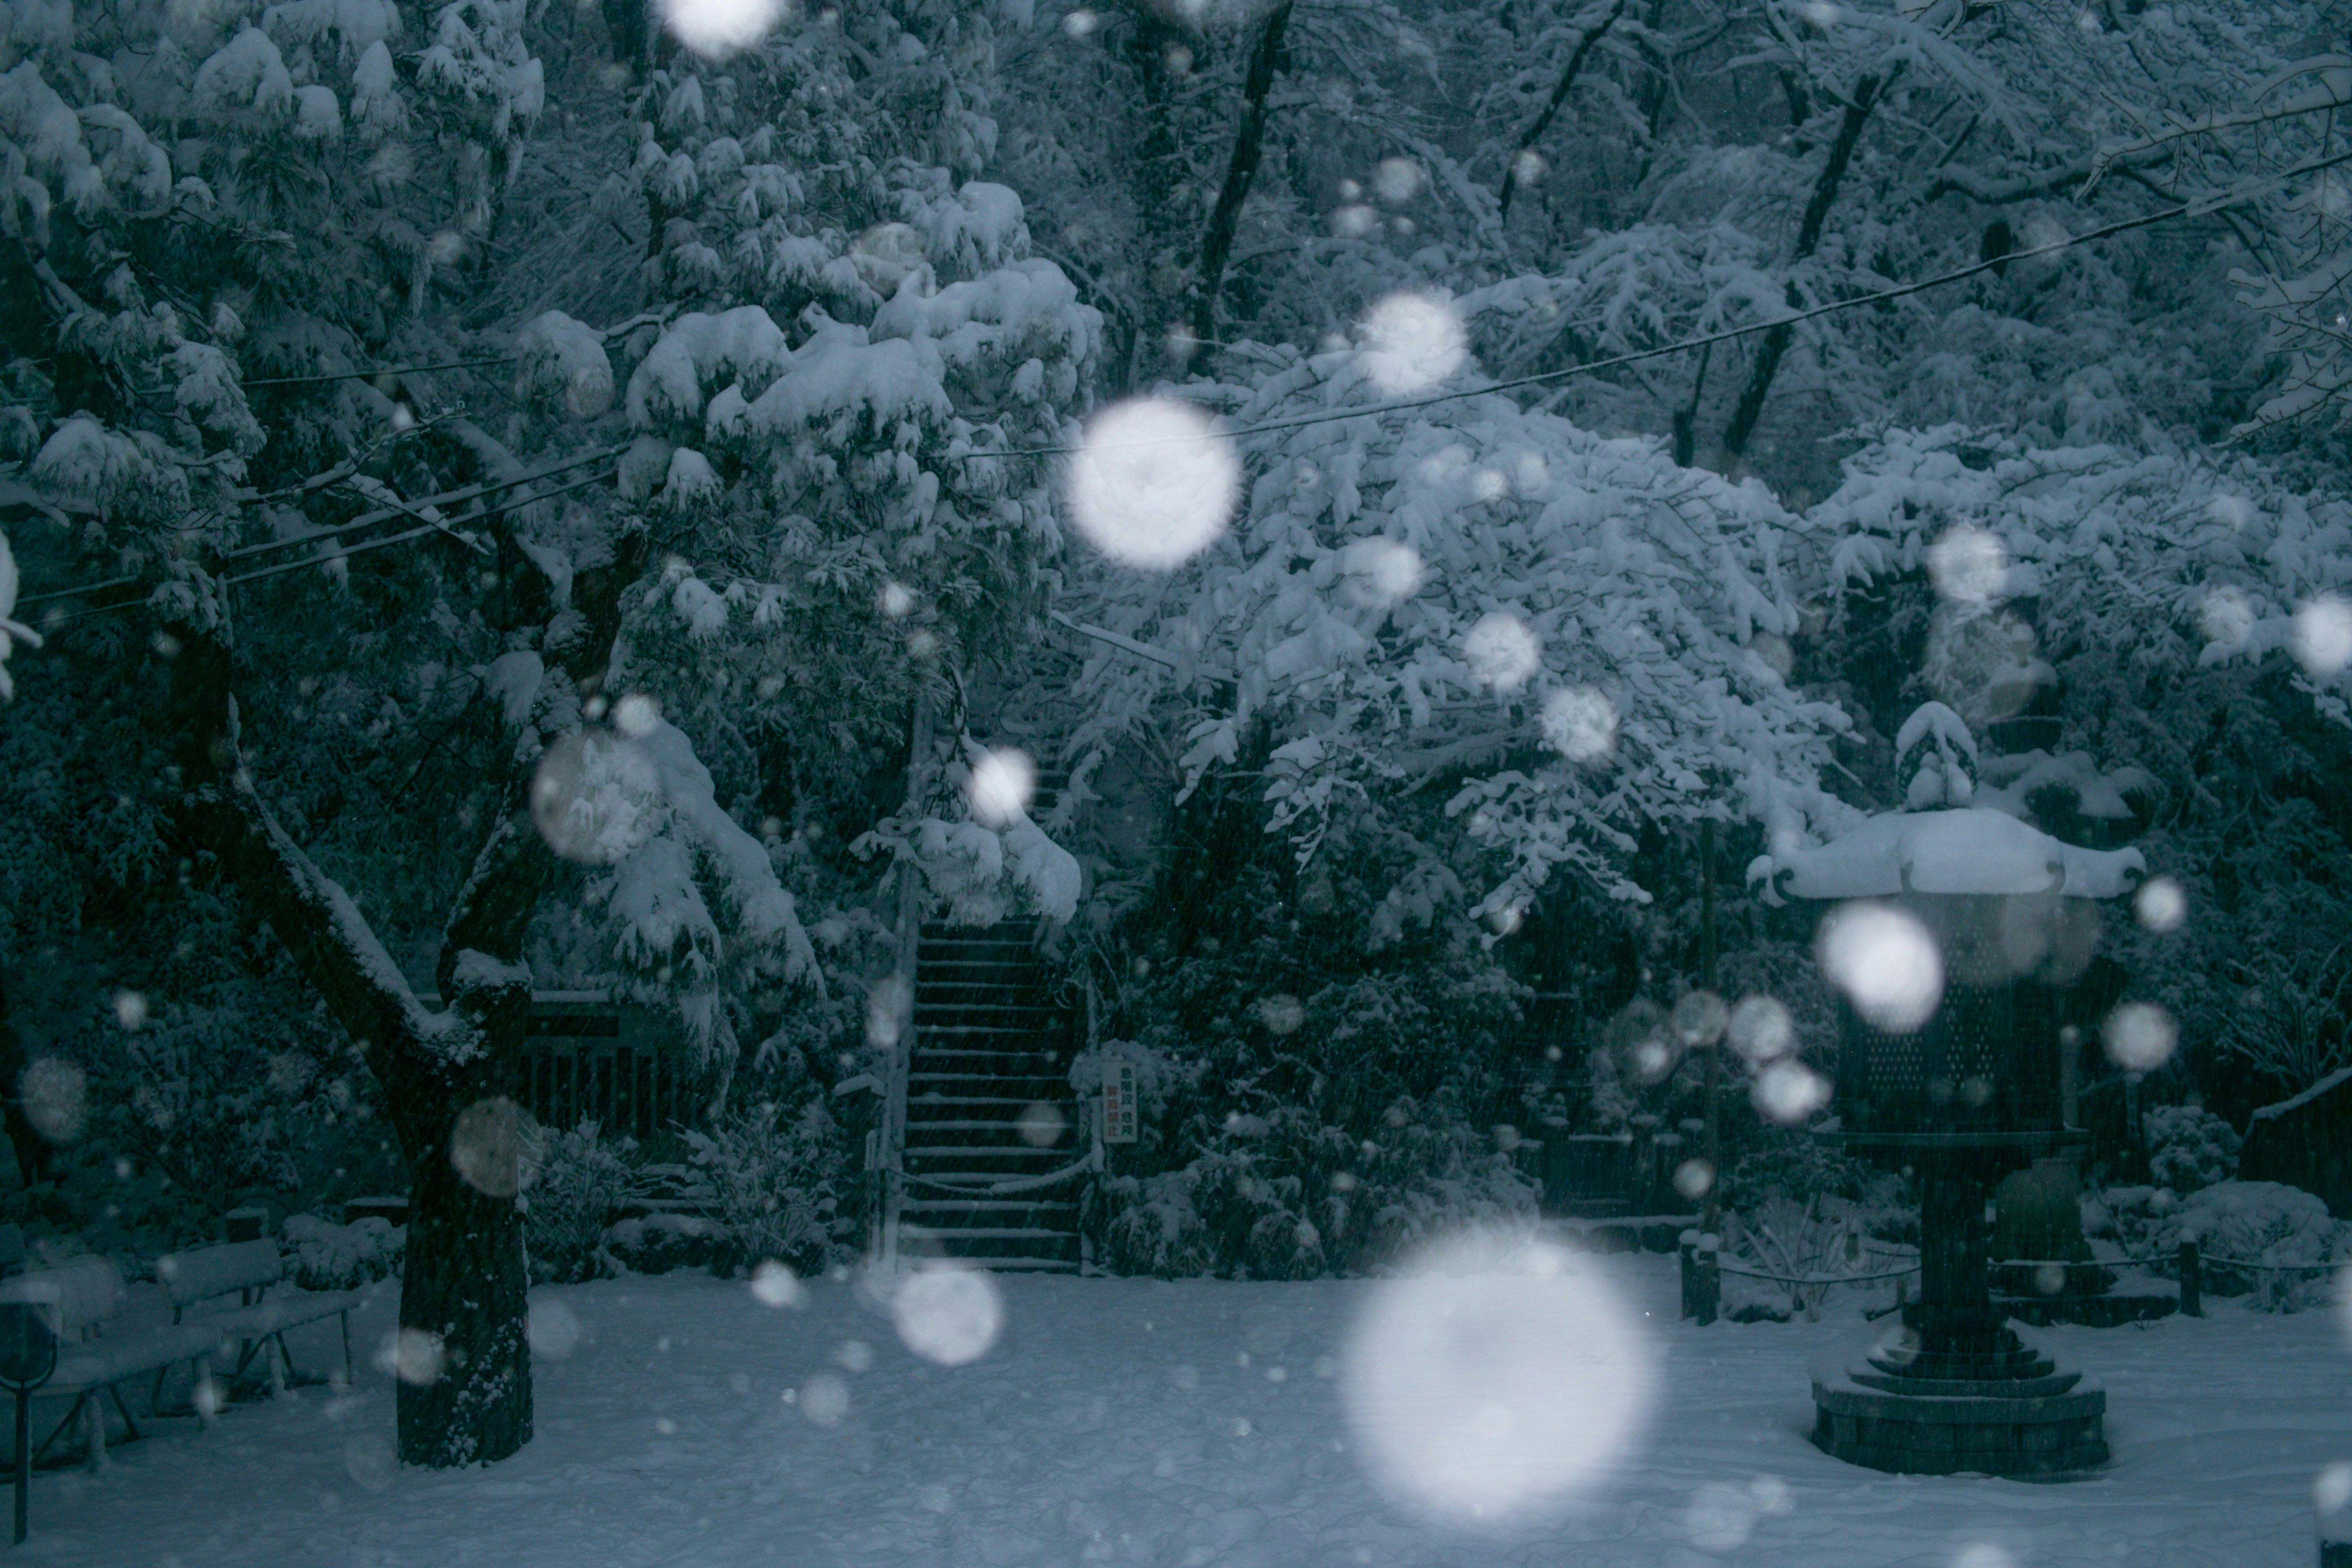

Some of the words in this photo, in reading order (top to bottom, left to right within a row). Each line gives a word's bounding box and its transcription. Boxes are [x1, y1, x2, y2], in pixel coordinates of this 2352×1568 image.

[1121, 1067, 1132, 1105] 急階段
[1122, 1111, 1133, 1135] 危険
